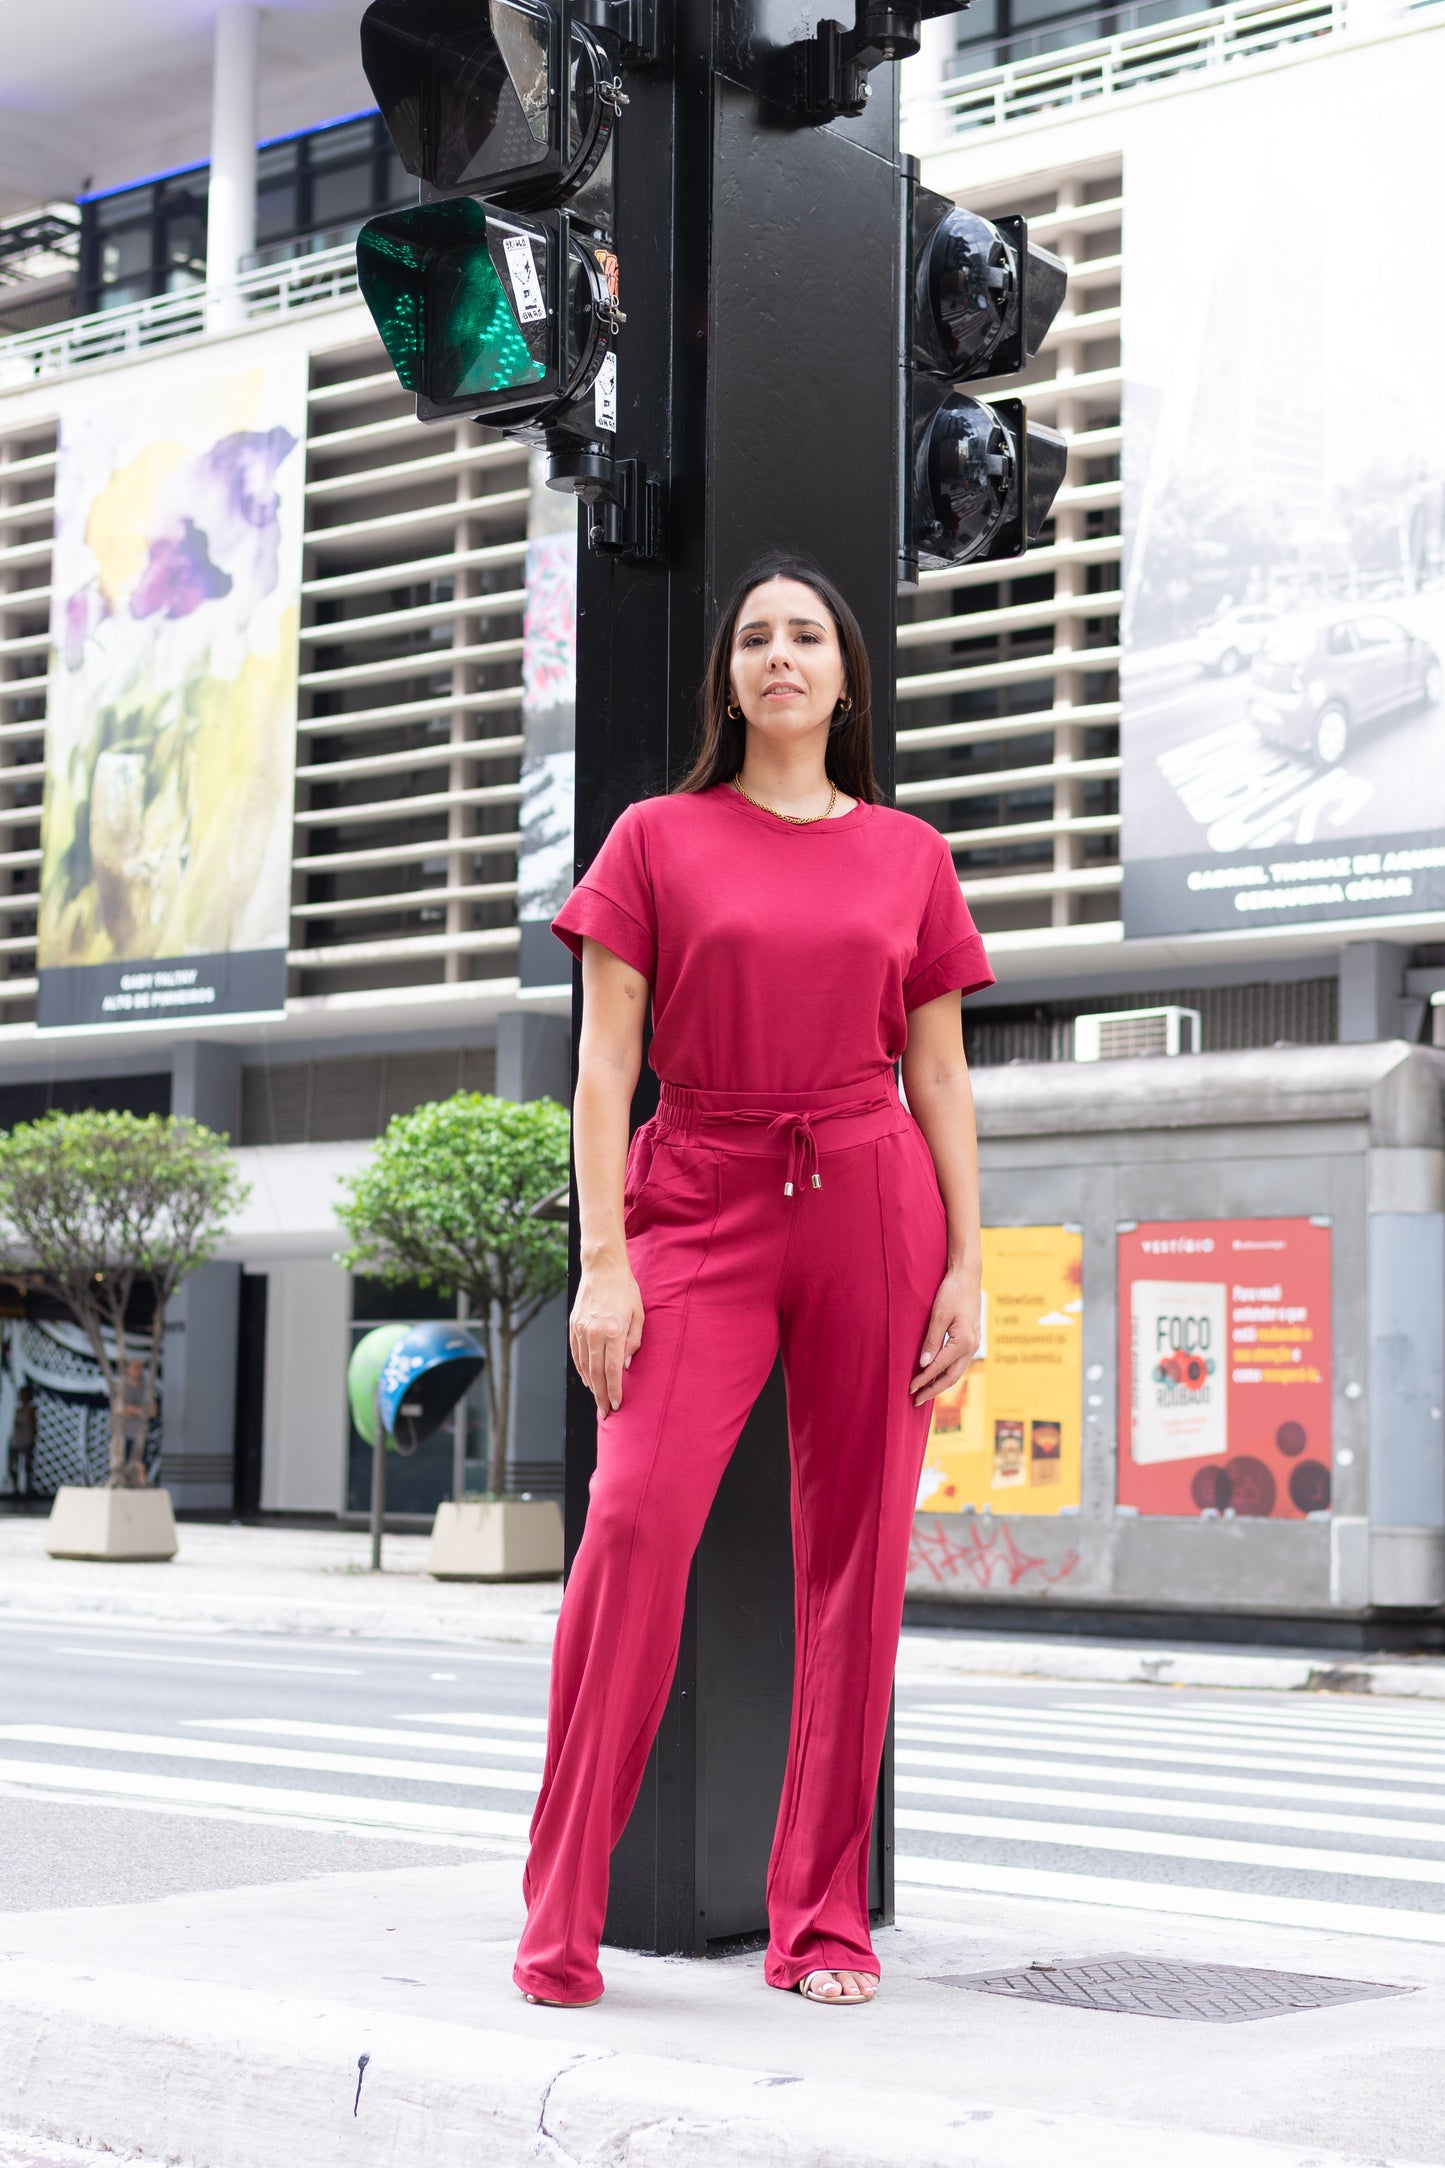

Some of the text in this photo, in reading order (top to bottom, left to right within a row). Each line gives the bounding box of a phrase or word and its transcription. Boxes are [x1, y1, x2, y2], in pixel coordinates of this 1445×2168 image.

[1352, 853, 1382, 876] DE
[1234, 876, 1413, 911] CERQUEIRA CÉSAR
[102, 986, 216, 1012] ALTO DE PINHEIROS
[1142, 1237, 1215, 1254] VESTÍGIO
[1157, 1316, 1210, 1352] FOCO
